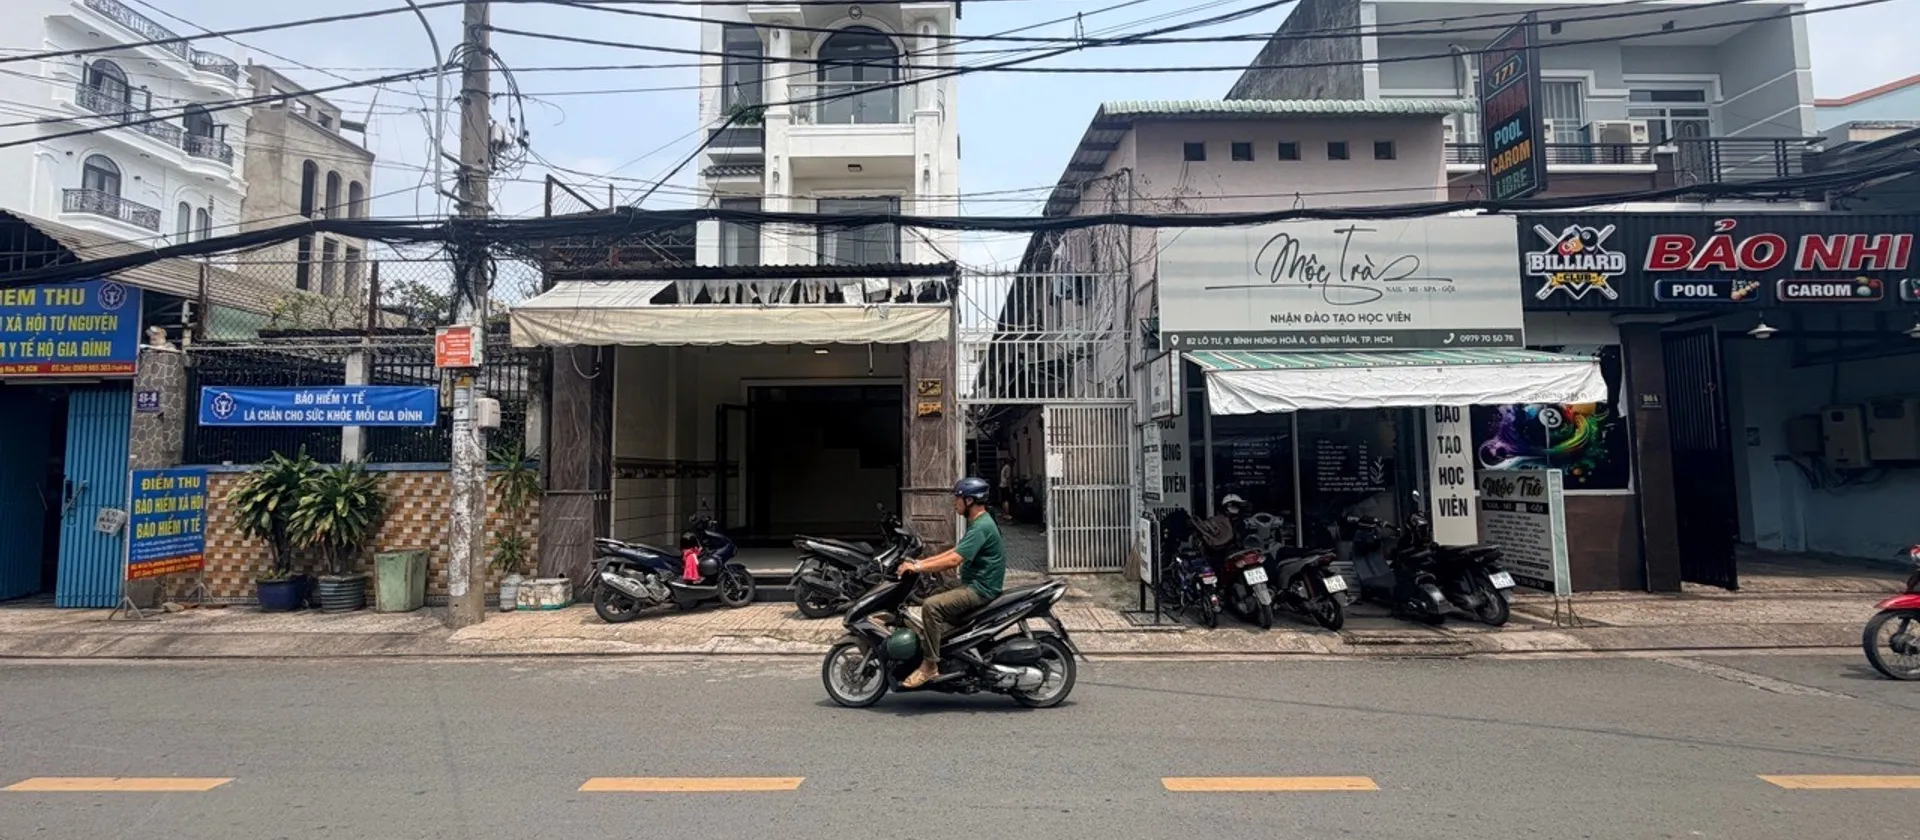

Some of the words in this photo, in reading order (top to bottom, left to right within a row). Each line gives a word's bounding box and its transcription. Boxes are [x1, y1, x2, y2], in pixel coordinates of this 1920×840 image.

[1494, 62, 1515, 84] 171
[1494, 118, 1523, 149] POOL
[1491, 140, 1532, 176] CAROM
[1496, 167, 1529, 198] LIBRE
[1643, 218, 1787, 271] BẢO
[1794, 233, 1914, 271] NHI
[1530, 254, 1624, 271] BILLIARD
[1563, 273, 1592, 281] CLUB
[43, 288, 86, 306] THU
[1672, 284, 1718, 297] POOL
[1787, 283, 1852, 297] CAROM
[5, 313, 23, 332] XÃ
[25, 312, 47, 336] HỘI
[50, 313, 67, 336] TỰ
[68, 311, 118, 336] NGUYỆN
[1270, 312, 1301, 326] NHẬN
[1304, 311, 1330, 324] ĐÀO
[1332, 313, 1356, 326] TẠO
[1358, 312, 1384, 325] HỌC
[1386, 310, 1412, 323] VIÊN
[9, 342, 16, 358] Y
[20, 336, 36, 358] TẾ
[38, 338, 54, 361] HỘ
[57, 341, 78, 358] GIA
[81, 337, 112, 357] ĐÌNH
[1361, 336, 1373, 344] TP.
[1374, 335, 1394, 344] HCM
[1460, 334, 1480, 343] 0979
[1481, 334, 1491, 343] 70
[1492, 334, 1503, 343] 50
[1504, 334, 1515, 343] 78
[138, 392, 157, 402] 84
[295, 390, 314, 405] BẢO
[316, 388, 339, 405] HIỂM
[342, 393, 350, 405] Y
[352, 389, 365, 405] TẾ
[244, 409, 257, 421] LÁ
[258, 408, 282, 422] CHẮN
[284, 411, 304, 422] CHO
[306, 407, 325, 422] SỨC
[327, 408, 352, 422] KHỎE
[355, 406, 374, 422] MỖI
[377, 411, 394, 422] GIA
[398, 408, 423, 422] ĐÌNH
[1437, 435, 1462, 459] TẠO
[141, 473, 174, 490] ĐIỂM
[178, 476, 201, 489] THU
[1162, 471, 1186, 493] UYÊN
[1438, 466, 1465, 490] HỌC
[135, 493, 153, 515] BẢO
[155, 490, 177, 513] HIỂM
[1438, 493, 1469, 517] VIÊN
[136, 517, 156, 539] BẢO
[158, 513, 181, 537] HIỂM
[183, 519, 189, 534] Y
[191, 513, 202, 533] TẾ
